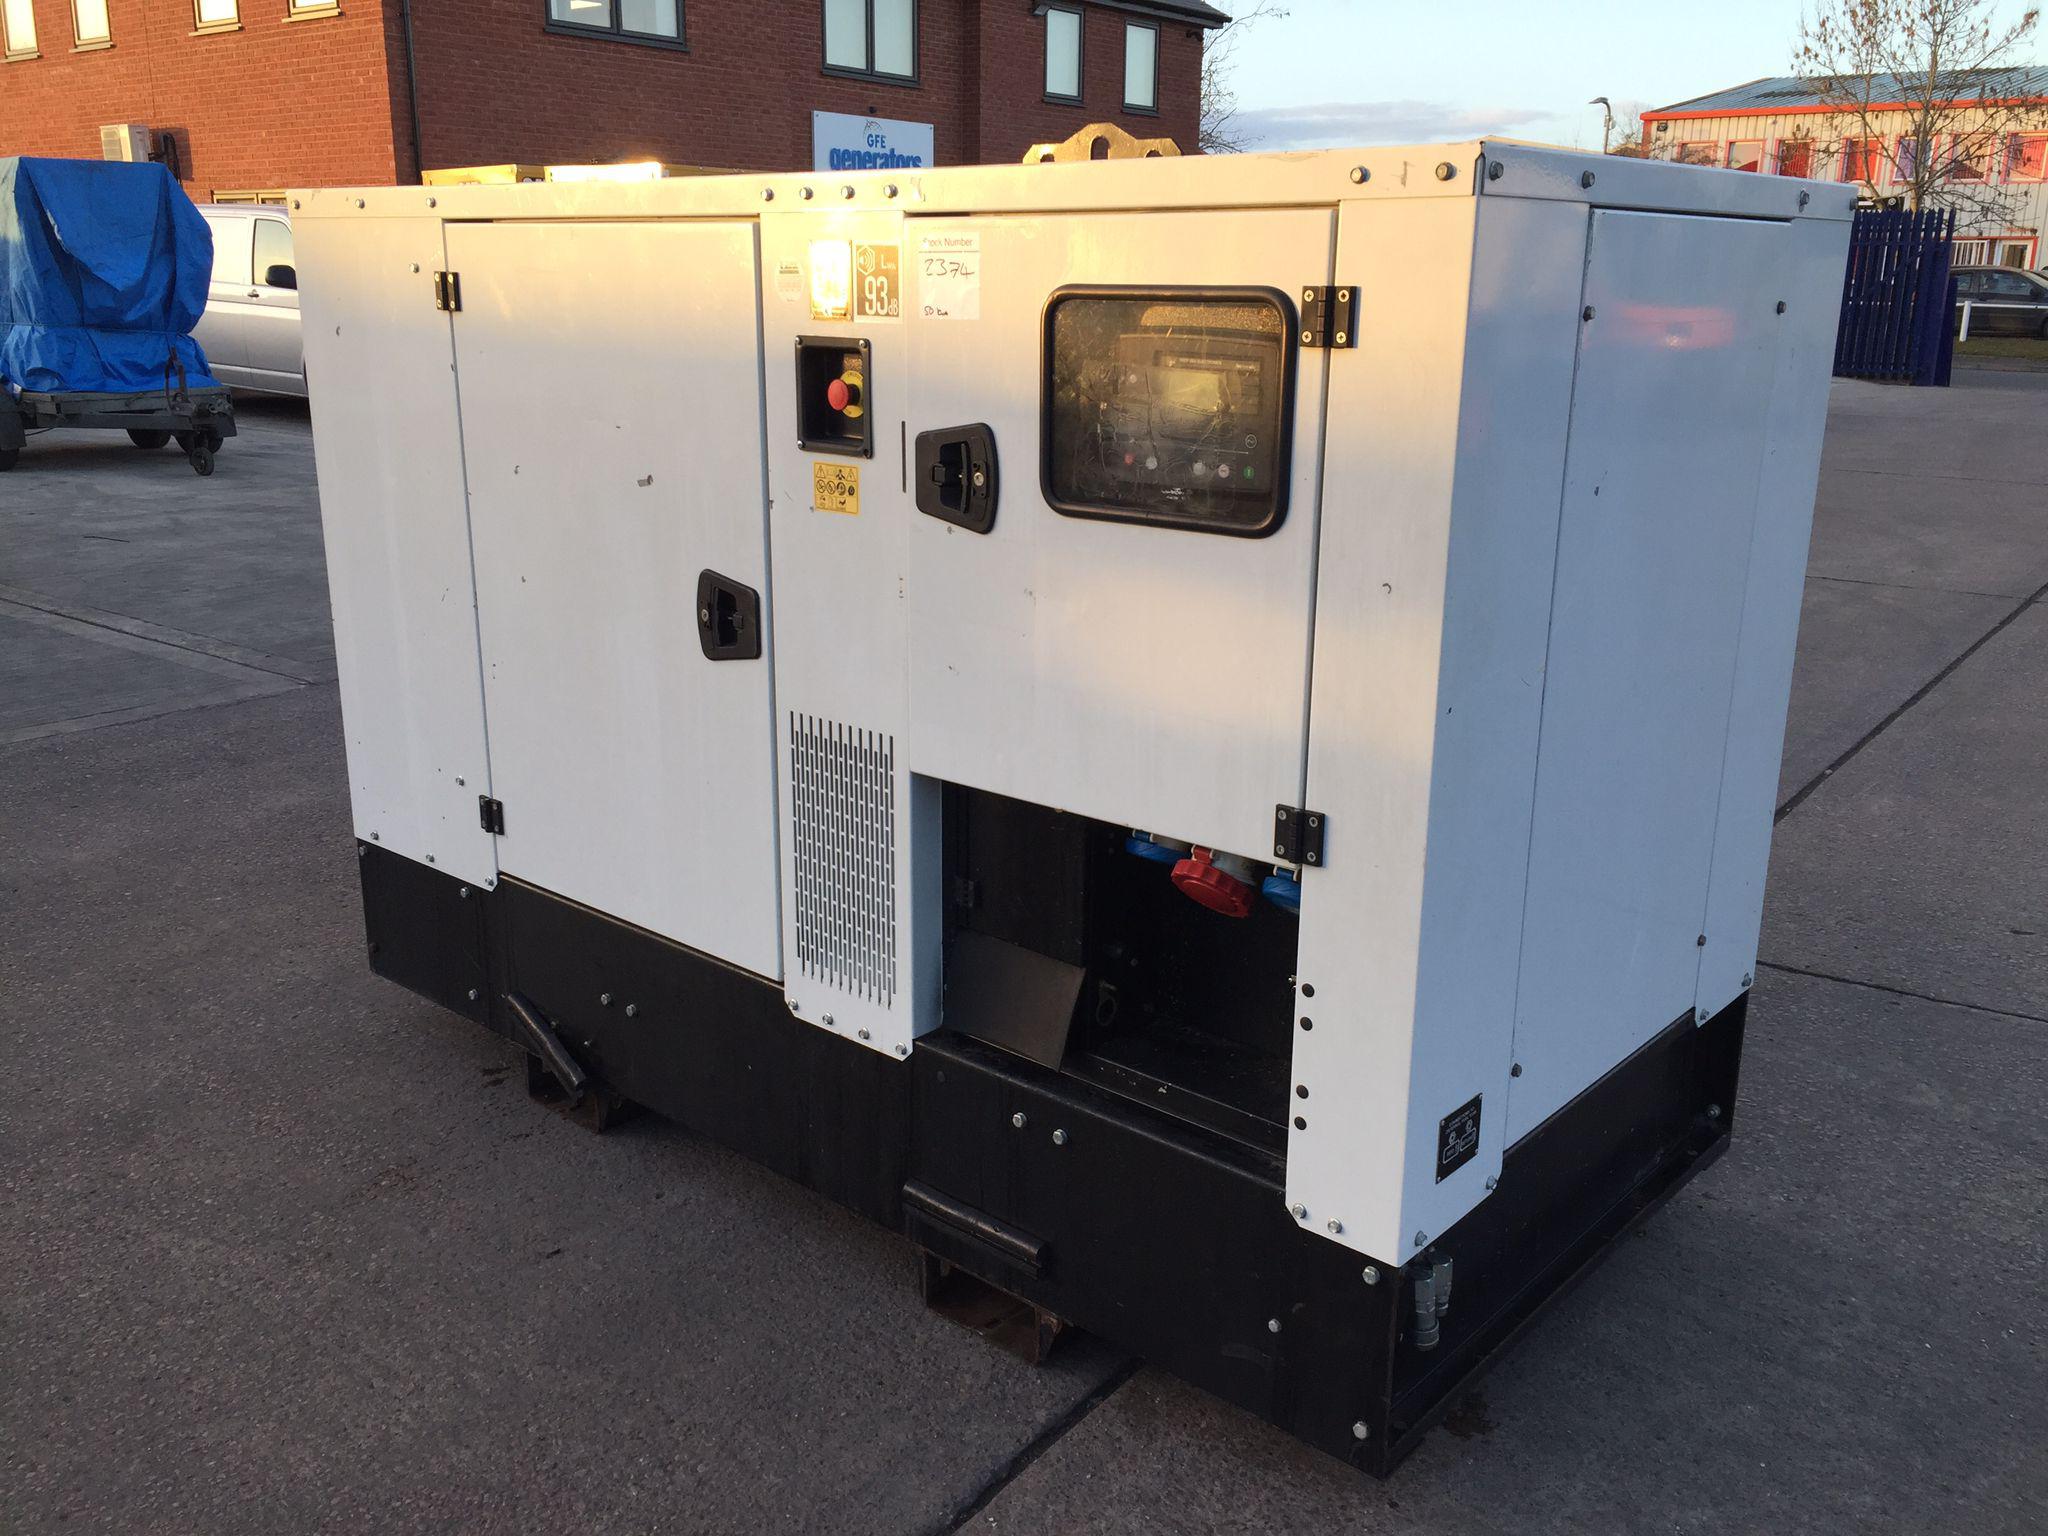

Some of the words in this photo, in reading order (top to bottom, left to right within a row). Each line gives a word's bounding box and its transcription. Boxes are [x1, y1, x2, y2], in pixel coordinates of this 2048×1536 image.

[867, 133, 887, 149] GFE
[829, 147, 922, 171] generators
[944, 237, 973, 247] Number
[924, 258, 975, 280] 2374
[865, 275, 888, 316] 93
[888, 297, 899, 316] dB
